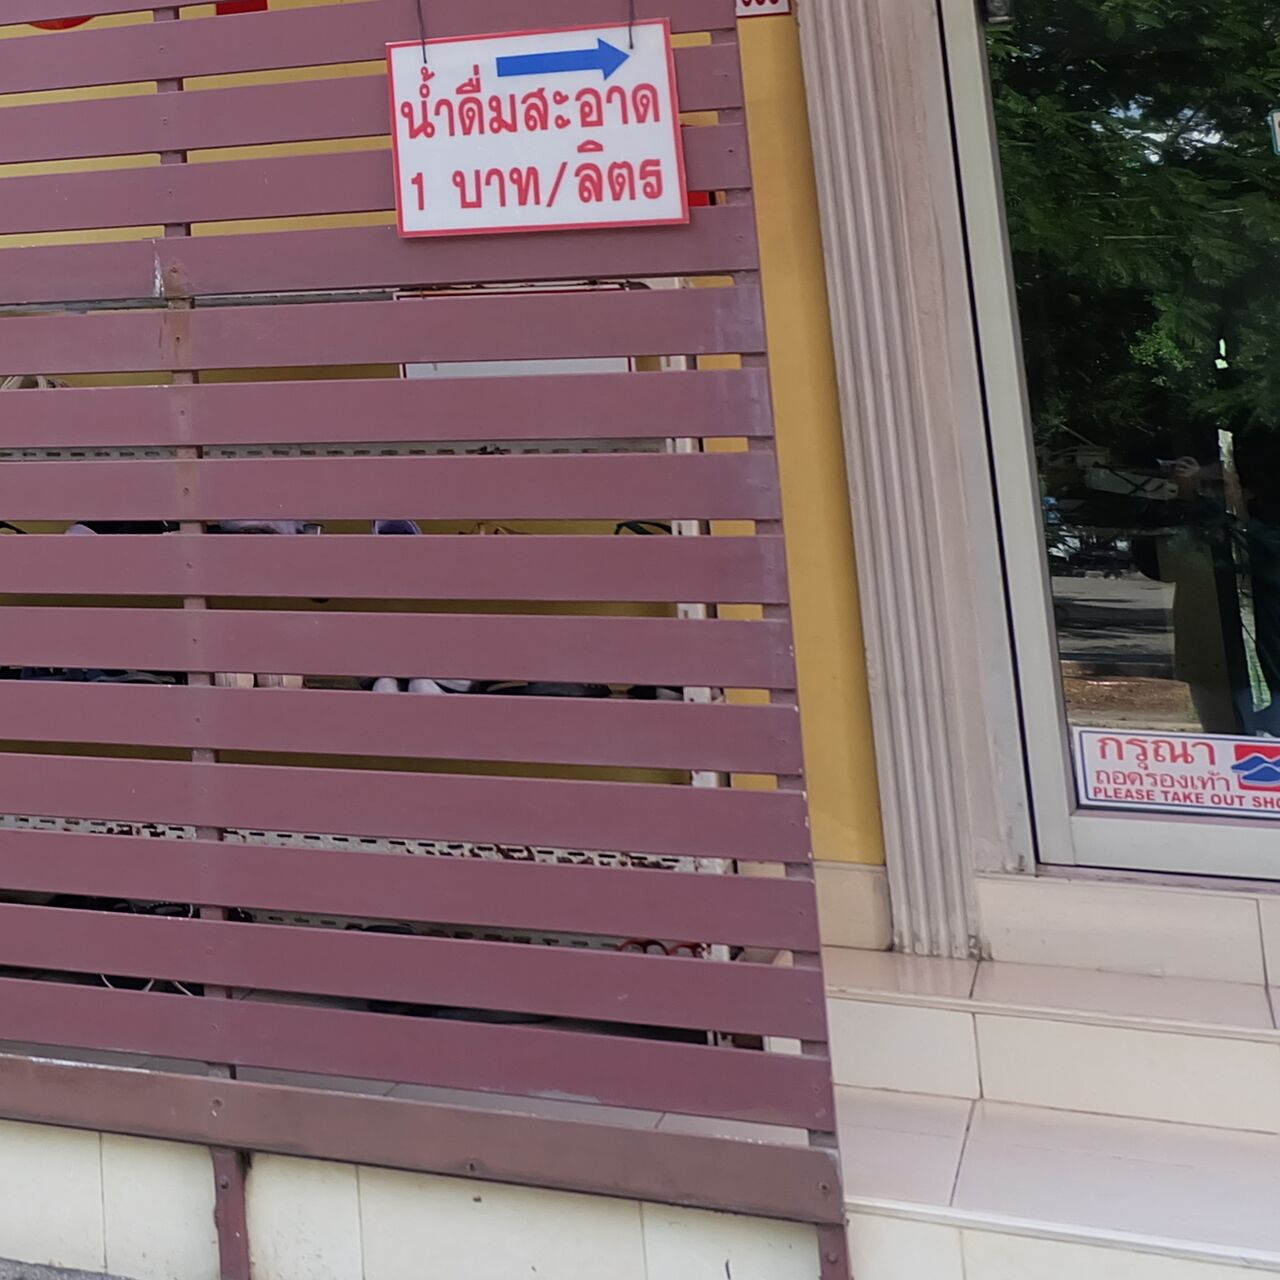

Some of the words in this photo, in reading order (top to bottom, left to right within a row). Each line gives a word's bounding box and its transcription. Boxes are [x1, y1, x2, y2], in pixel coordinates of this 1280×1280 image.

[400, 64, 661, 141] น้ำดื่มสะอาด
[410, 171, 426, 211] 1
[1097, 736, 1217, 770] กรุณา
[1092, 786, 1156, 801] PLEASE
[1160, 790, 1205, 804] TAKE
[1210, 793, 1246, 807] OUT
[1095, 770, 1231, 792] ถอดรองเท้า
